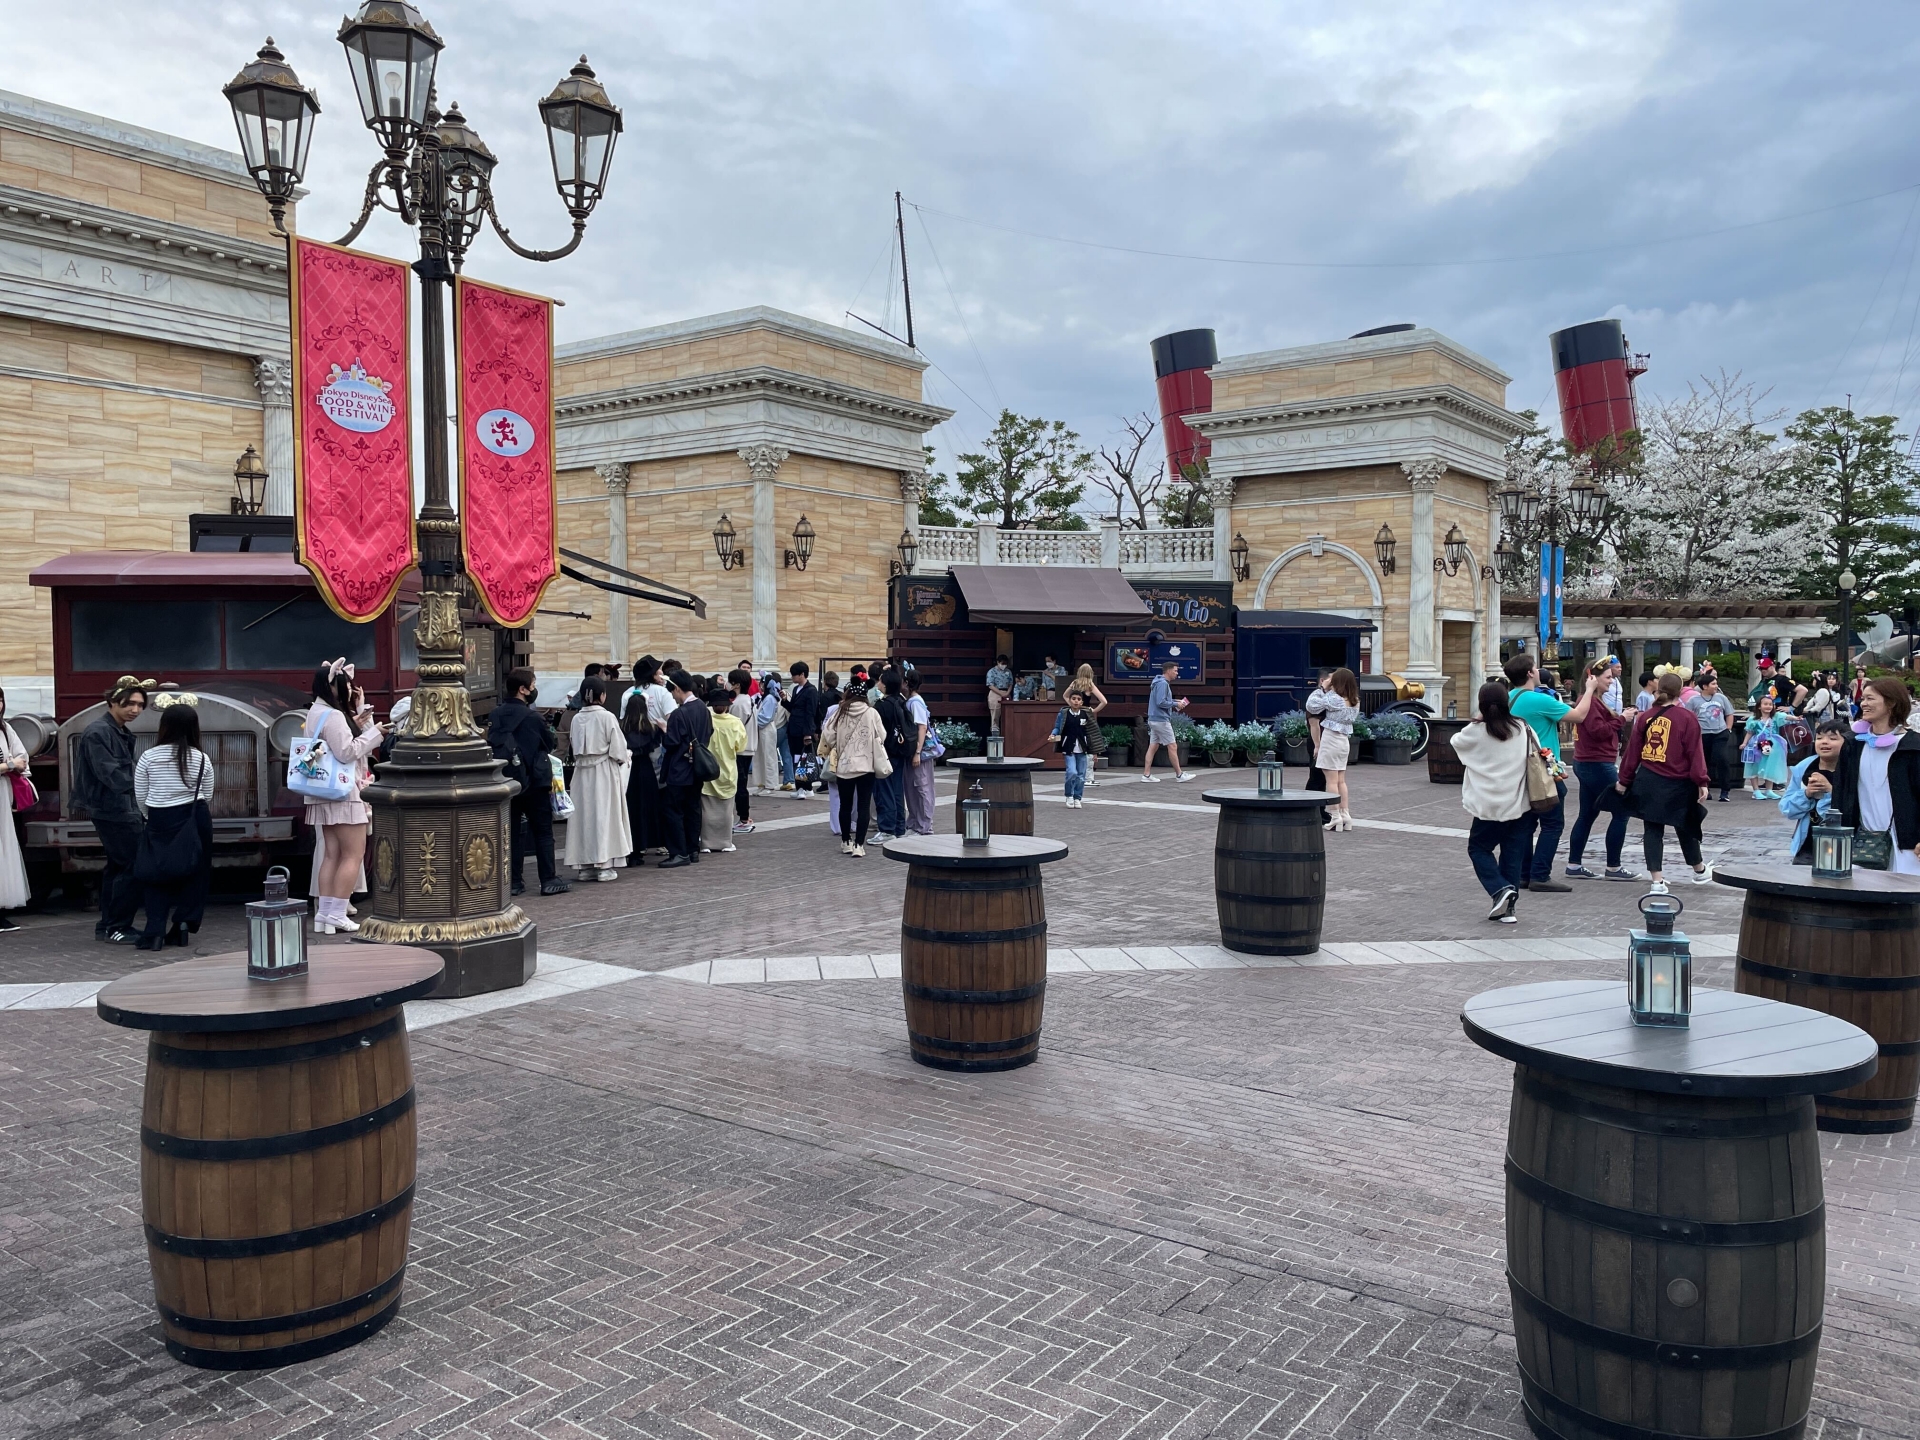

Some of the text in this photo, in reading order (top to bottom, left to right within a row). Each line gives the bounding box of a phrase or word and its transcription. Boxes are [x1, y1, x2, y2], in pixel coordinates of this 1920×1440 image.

[64, 259, 152, 291] ART
[318, 395, 396, 415] FOOD & WINE
[322, 387, 392, 405] Tokyo DisneySea
[330, 406, 386, 422] FESTIVAL
[813, 414, 881, 439] DANCE
[1255, 425, 1379, 449] COMEDY
